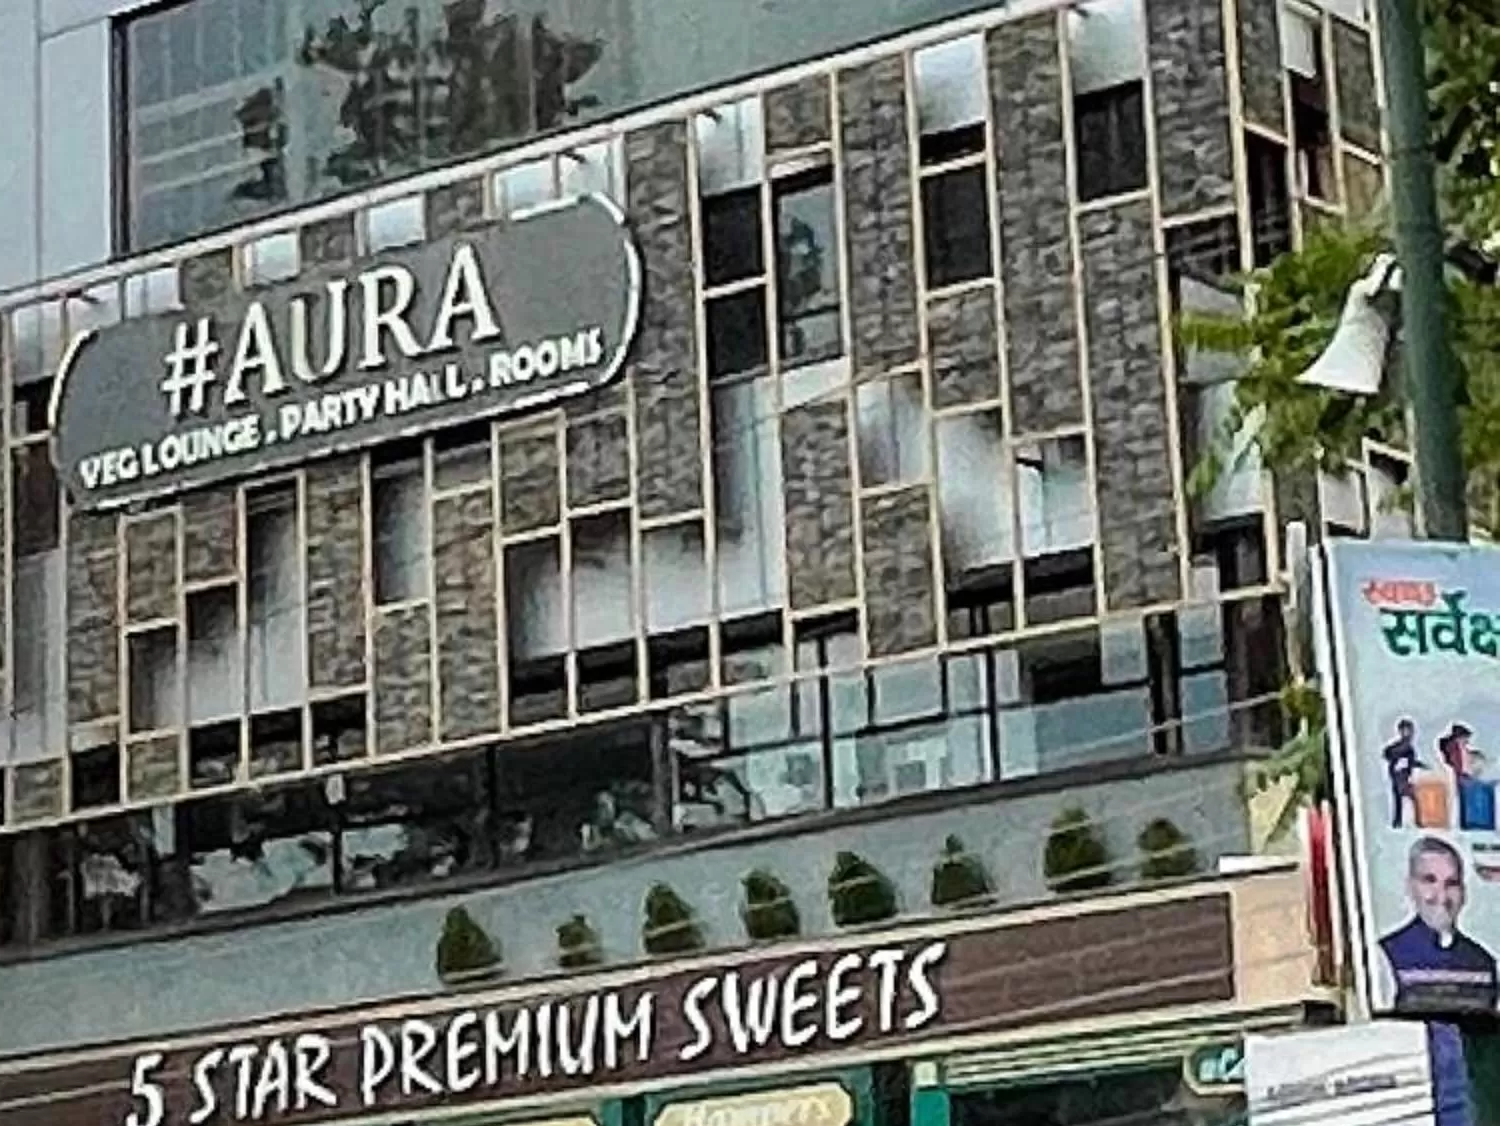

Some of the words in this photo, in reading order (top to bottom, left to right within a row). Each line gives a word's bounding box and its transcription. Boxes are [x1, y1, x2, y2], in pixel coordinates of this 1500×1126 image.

[78, 445, 140, 490] VEG
[278, 382, 381, 441] PARTY
[383, 363, 468, 415] HALL
[489, 326, 603, 389] ROOMS
[160, 241, 502, 417] #AURA
[188, 1032, 338, 1125] STAR
[360, 990, 654, 1107] PREMIUM
[678, 941, 947, 1062] SWEETS
